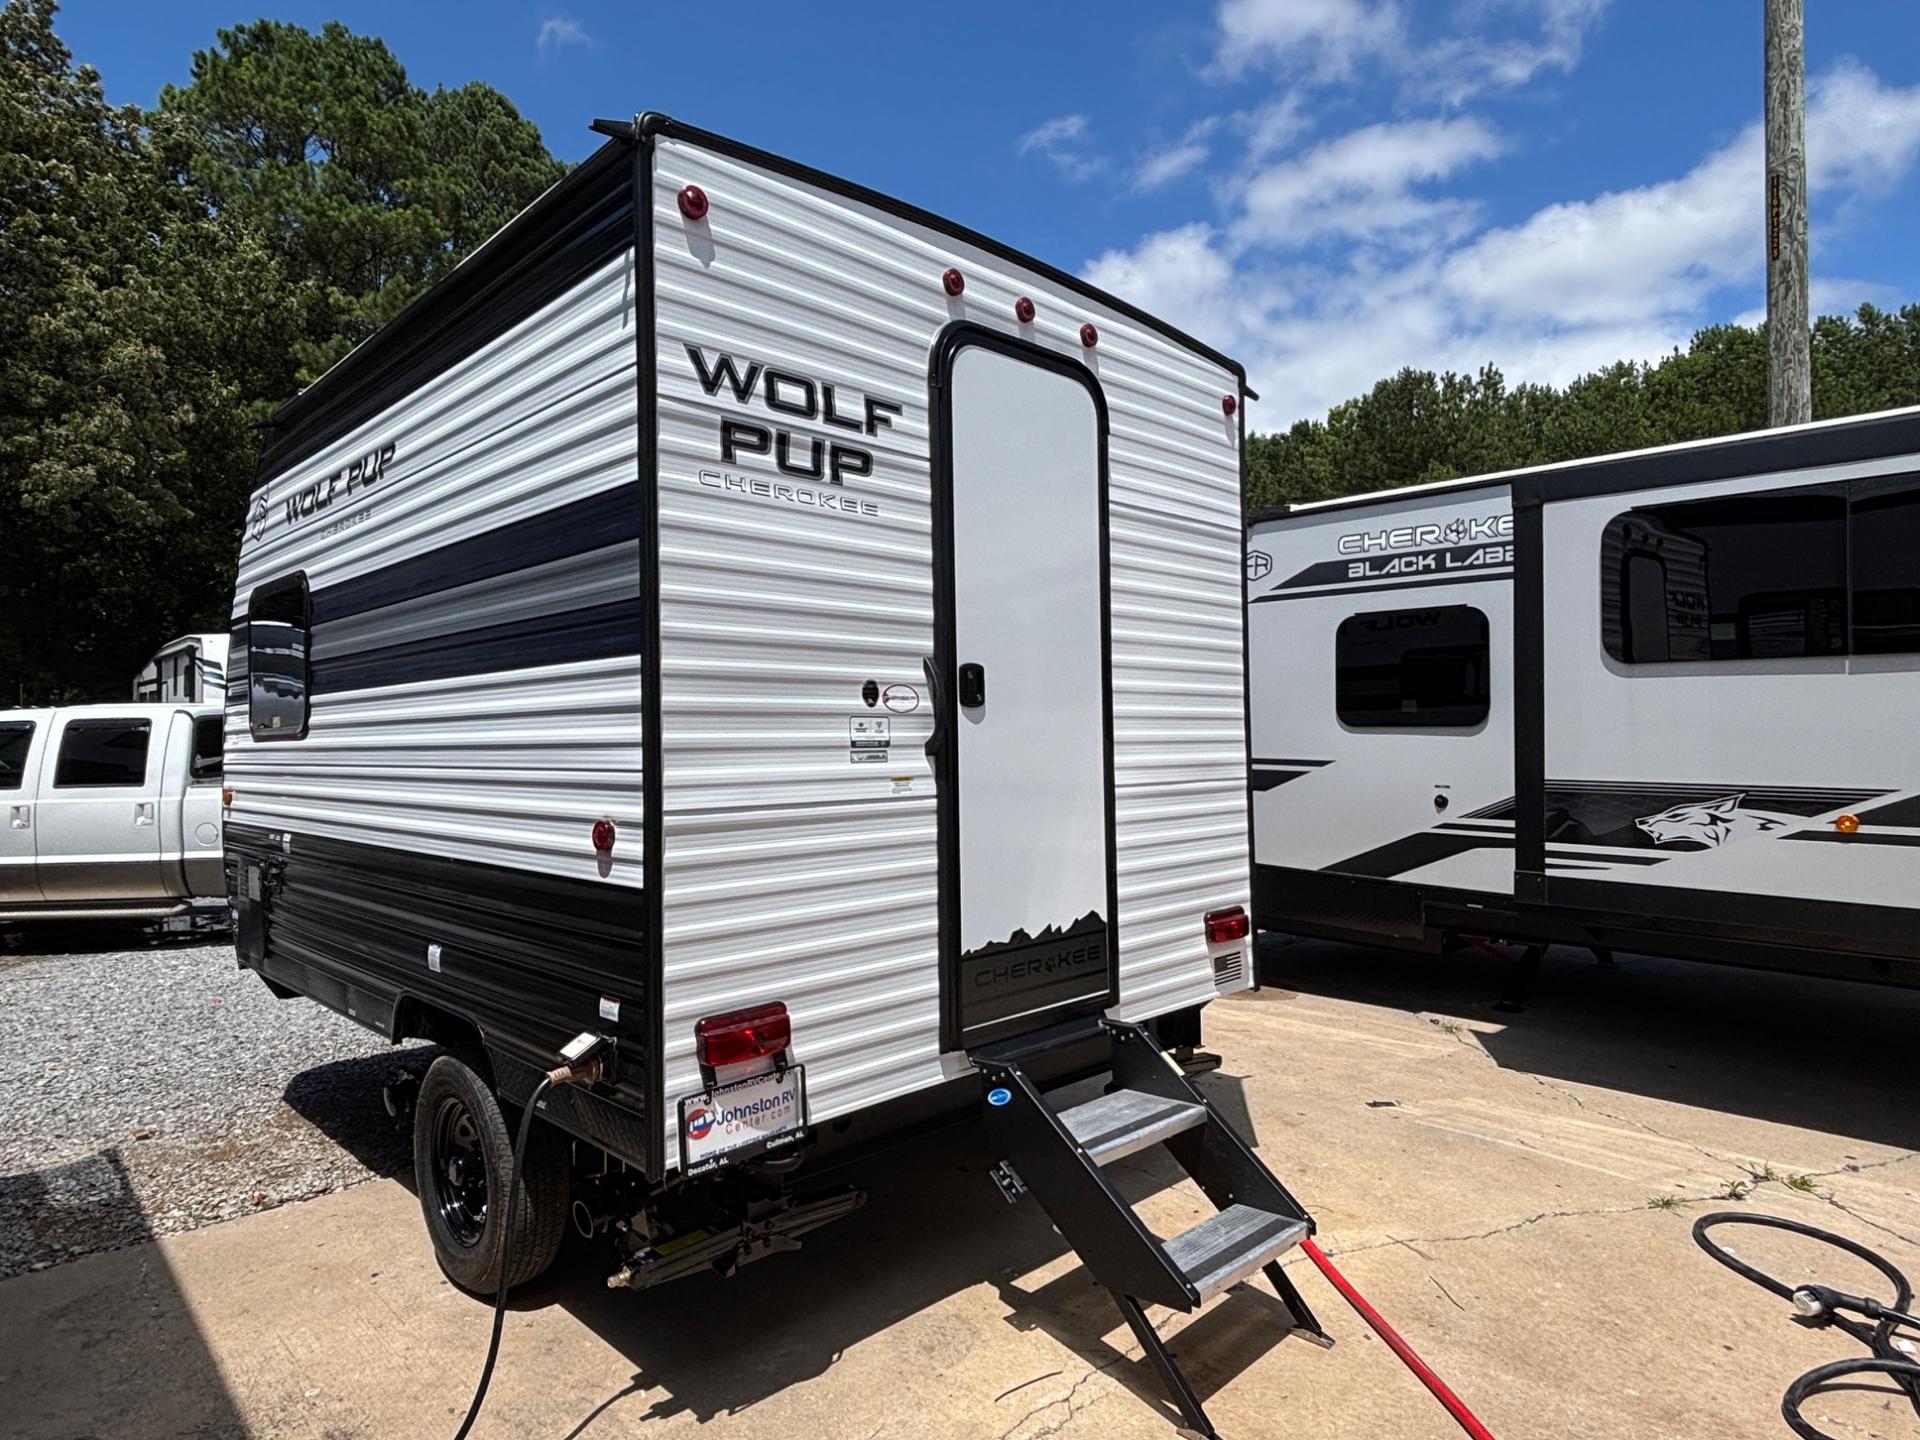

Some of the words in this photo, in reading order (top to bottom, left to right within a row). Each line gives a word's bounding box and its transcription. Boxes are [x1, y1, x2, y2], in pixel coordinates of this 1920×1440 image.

[683, 343, 902, 437] WOLF
[720, 415, 873, 486] PUP
[286, 472, 342, 524] WOLF
[347, 441, 396, 496] PUP
[699, 469, 879, 516] CHEROKEE
[1347, 553, 1436, 578] BLACK
[716, 1094, 780, 1126] Johnston
[782, 1088, 797, 1105] RV
[719, 1157, 729, 1166] AL
